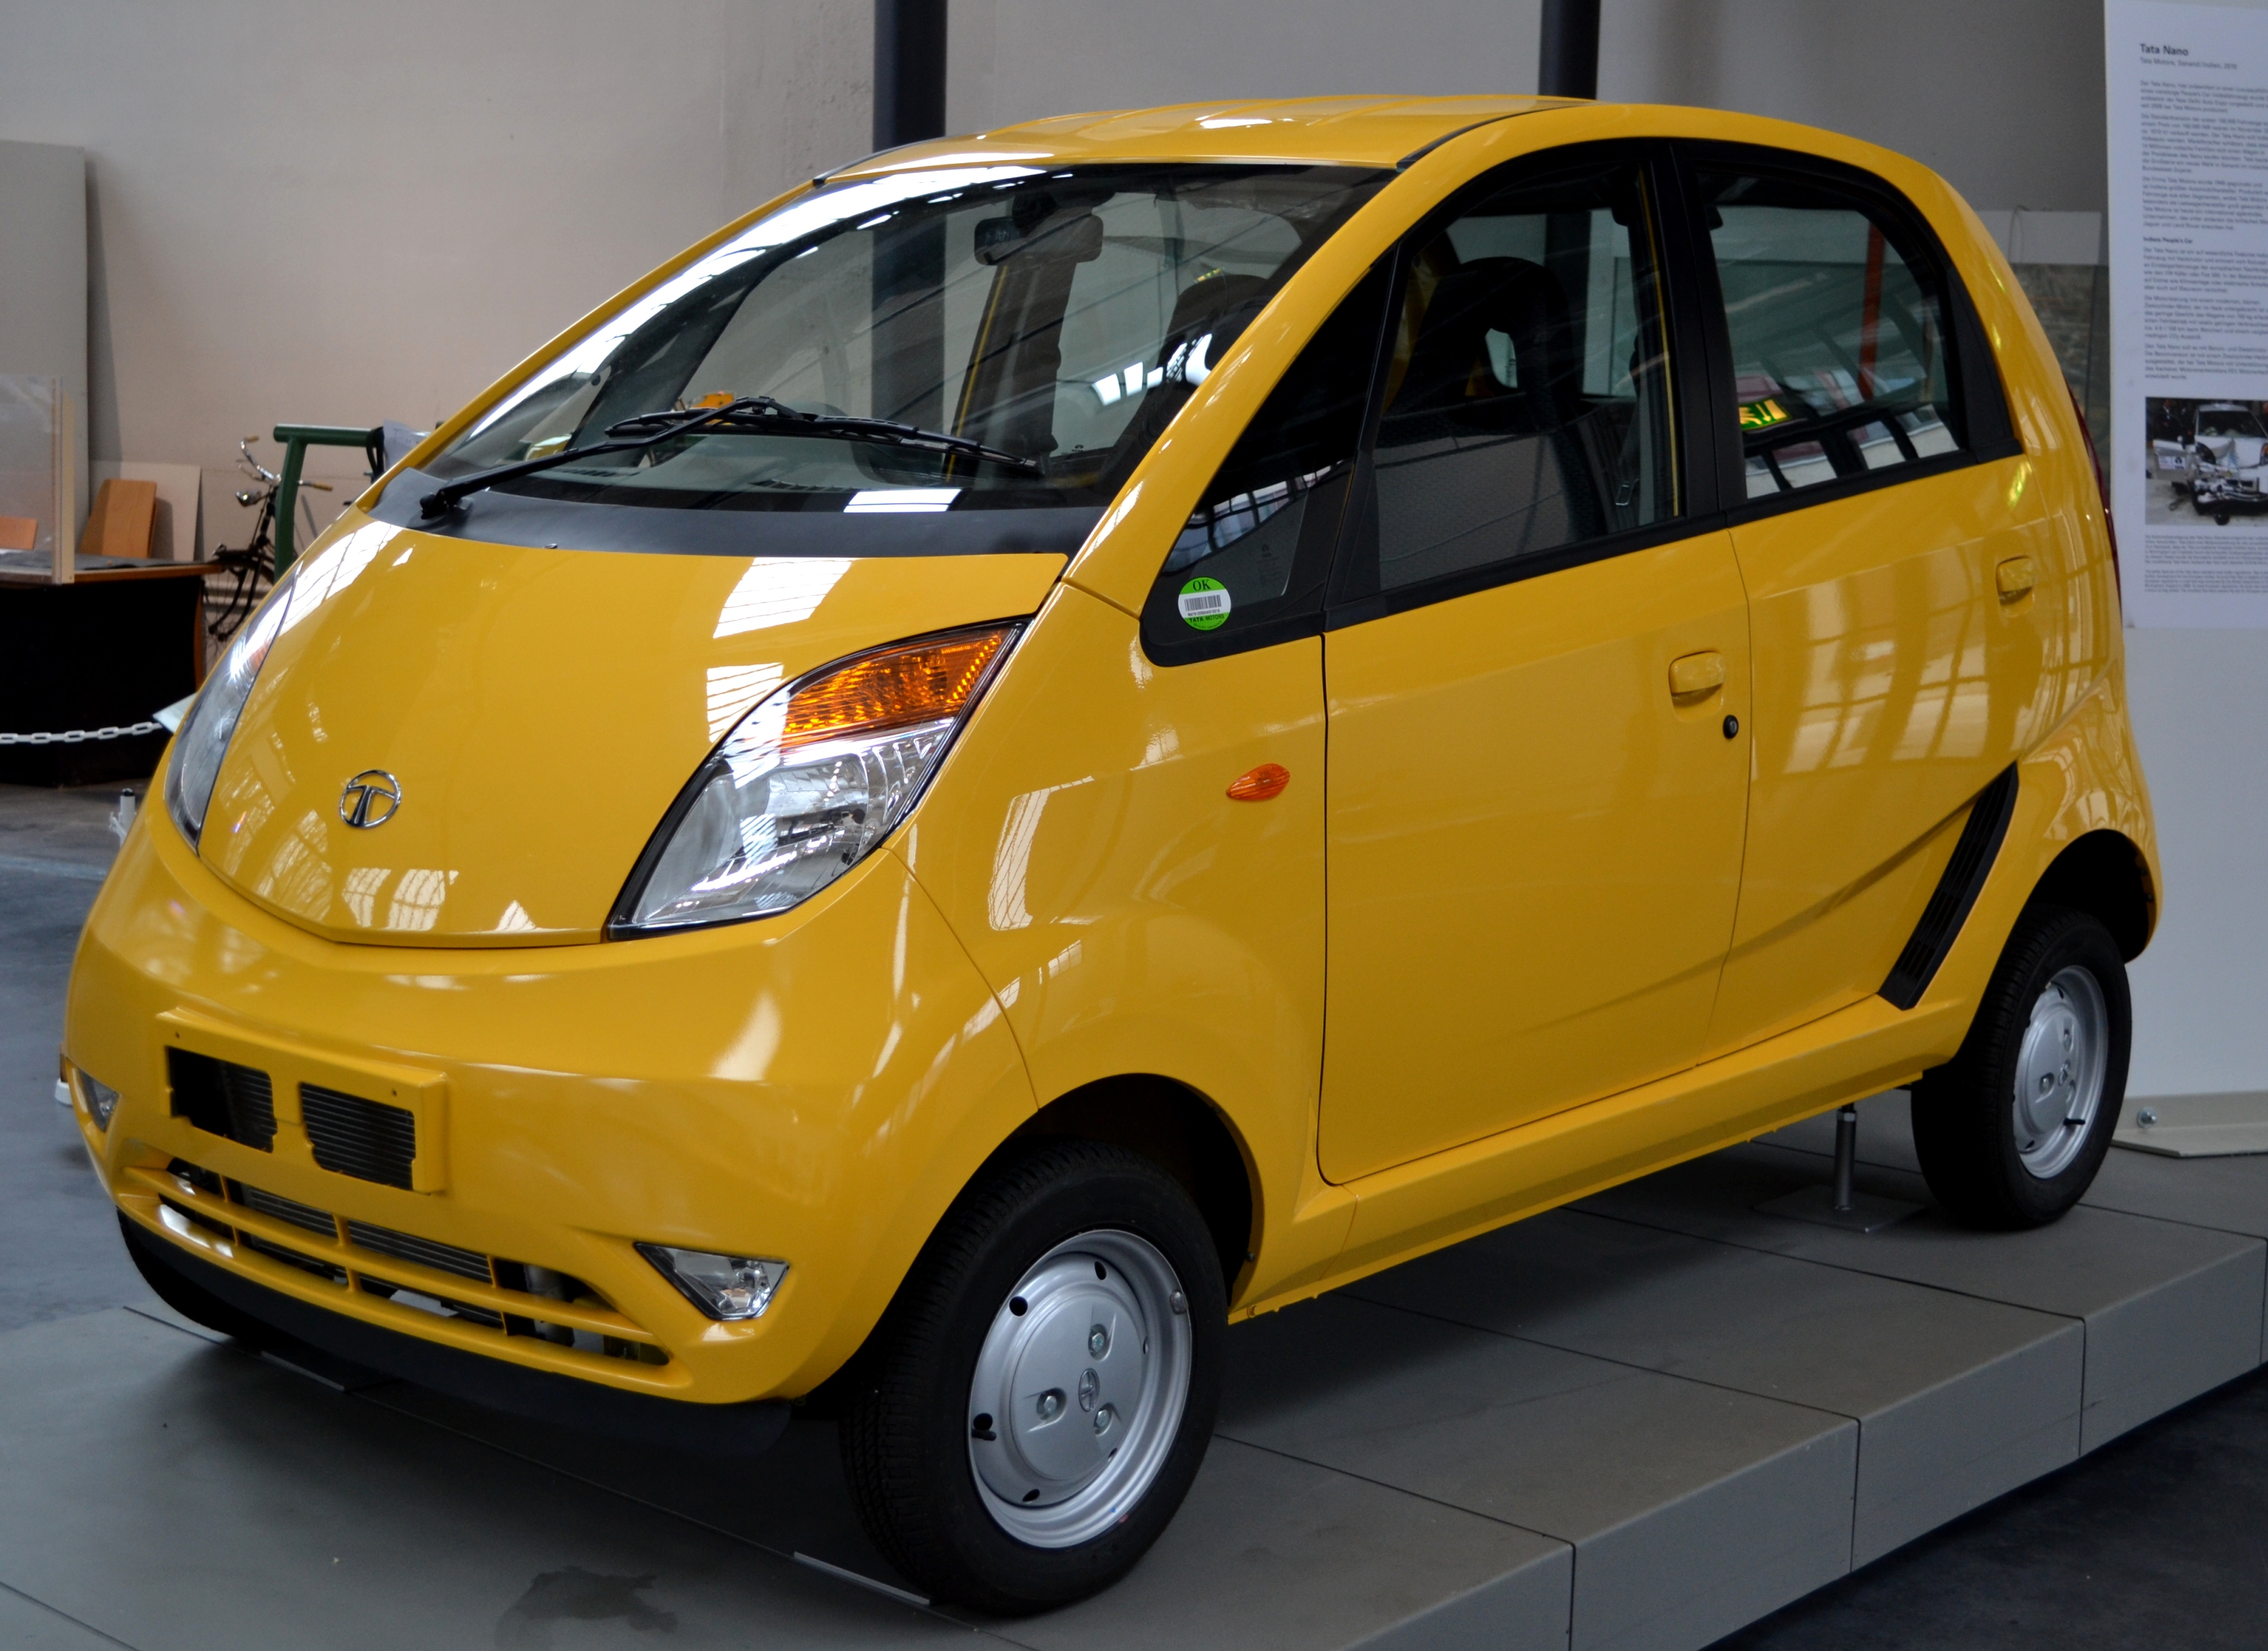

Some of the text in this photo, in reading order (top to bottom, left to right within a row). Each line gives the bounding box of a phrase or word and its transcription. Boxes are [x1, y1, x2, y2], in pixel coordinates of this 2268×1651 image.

[2140, 43, 2189, 56] Tata Nano
[1193, 580, 1211, 591] OK
